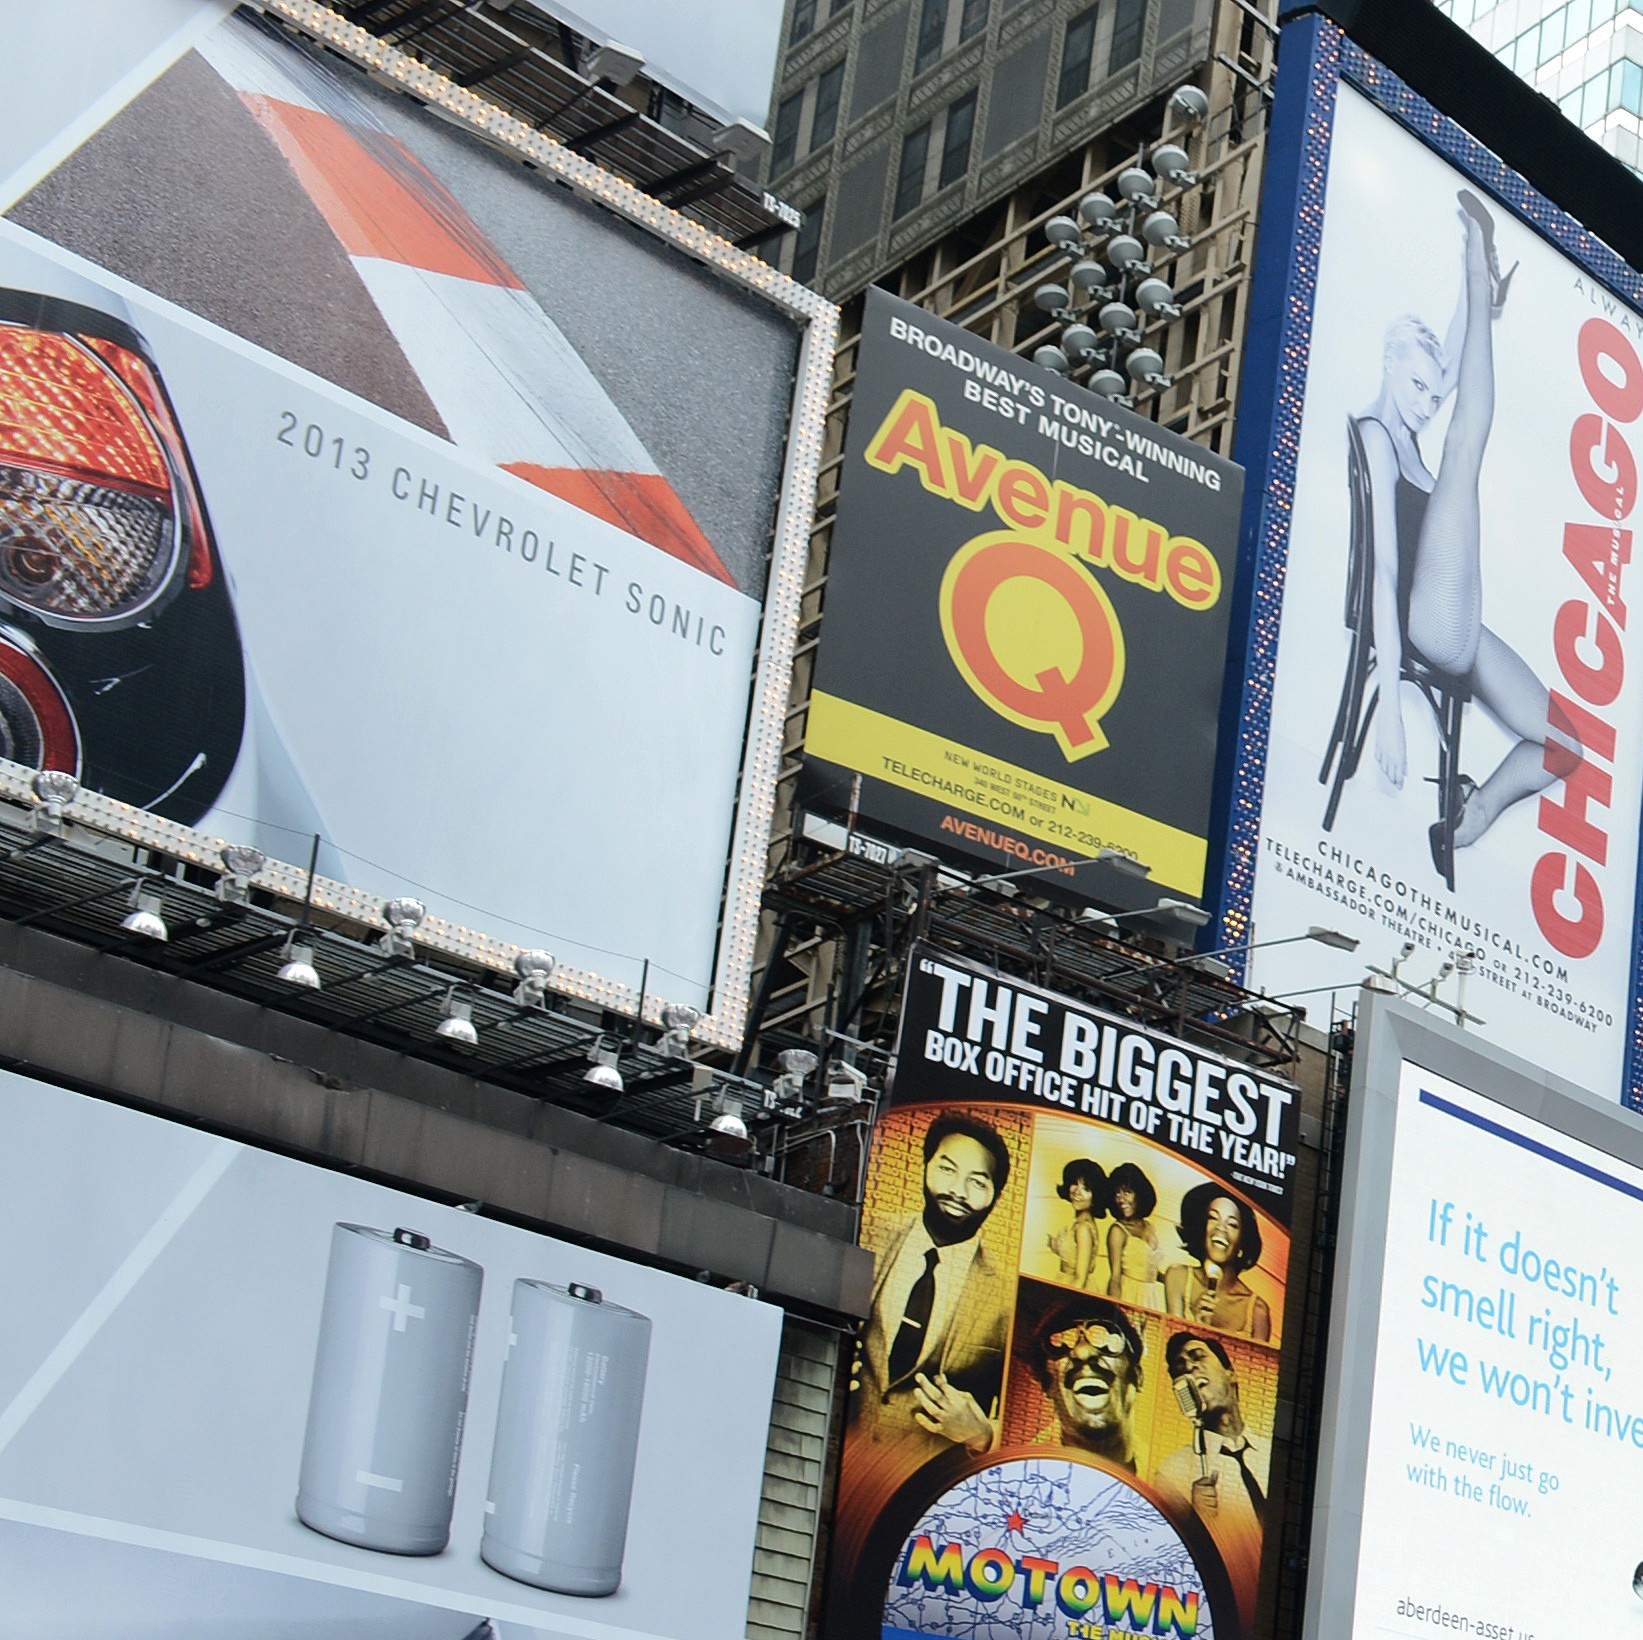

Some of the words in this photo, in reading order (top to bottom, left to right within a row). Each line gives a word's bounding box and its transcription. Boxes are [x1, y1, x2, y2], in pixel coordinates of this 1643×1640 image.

[963, 378, 1031, 426] BEST
[1036, 417, 1150, 483] MUSICAL
[277, 411, 370, 482] 2013
[391, 466, 611, 597] CHEVROLET
[625, 582, 727, 658] SONIC
[864, 388, 1222, 611] Avenue
[1611, 485, 1626, 567] MUSICAL
[1607, 572, 1618, 606] THE
[939, 528, 1126, 764] Q
[882, 756, 1026, 821] TELECHARGE.COM
[1029, 813, 1045, 829] or
[943, 750, 971, 769] NEW
[973, 760, 1012, 784] WORLD
[1015, 777, 1058, 802] STAGES
[940, 815, 1076, 877] AVENUEQ.COM
[1265, 837, 1487, 962] TELECHARGE.COM/CHICAGO
[1513, 965, 1614, 1028] 212-239-6200
[1286, 866, 1376, 921] AMBASSADOR
[1381, 913, 1432, 950] THEATRE
[1478, 965, 1518, 994] STREET
[1536, 994, 1598, 1034] BROADWAY
[1318, 840, 1569, 984] CHICAGOTHEMUSICAL.COM
[924, 1029, 979, 1077] BOX
[985, 1050, 1076, 1109] OFFICE
[1081, 1082, 1126, 1122] HIT
[1128, 1100, 1162, 1136] OF
[1165, 1112, 1215, 1157] THE
[1060, 1010, 1293, 1148] BIGGEST
[1428, 1198, 1455, 1248] If
[1462, 1210, 1488, 1263] it
[1498, 1230, 1621, 1316] doesn’t
[1417, 1337, 1470, 1387] we
[1478, 1358, 1573, 1424] won’t
[1421, 1273, 1516, 1341] smell
[1527, 1308, 1614, 1384] right,
[1407, 1463, 1448, 1493] with
[1453, 1474, 1484, 1502] the
[1488, 1485, 1531, 1518] flow.
[1408, 1422, 1441, 1455] We
[1445, 1438, 1497, 1471] never
[1500, 1451, 1536, 1483] just
[1538, 1469, 1560, 1494] go
